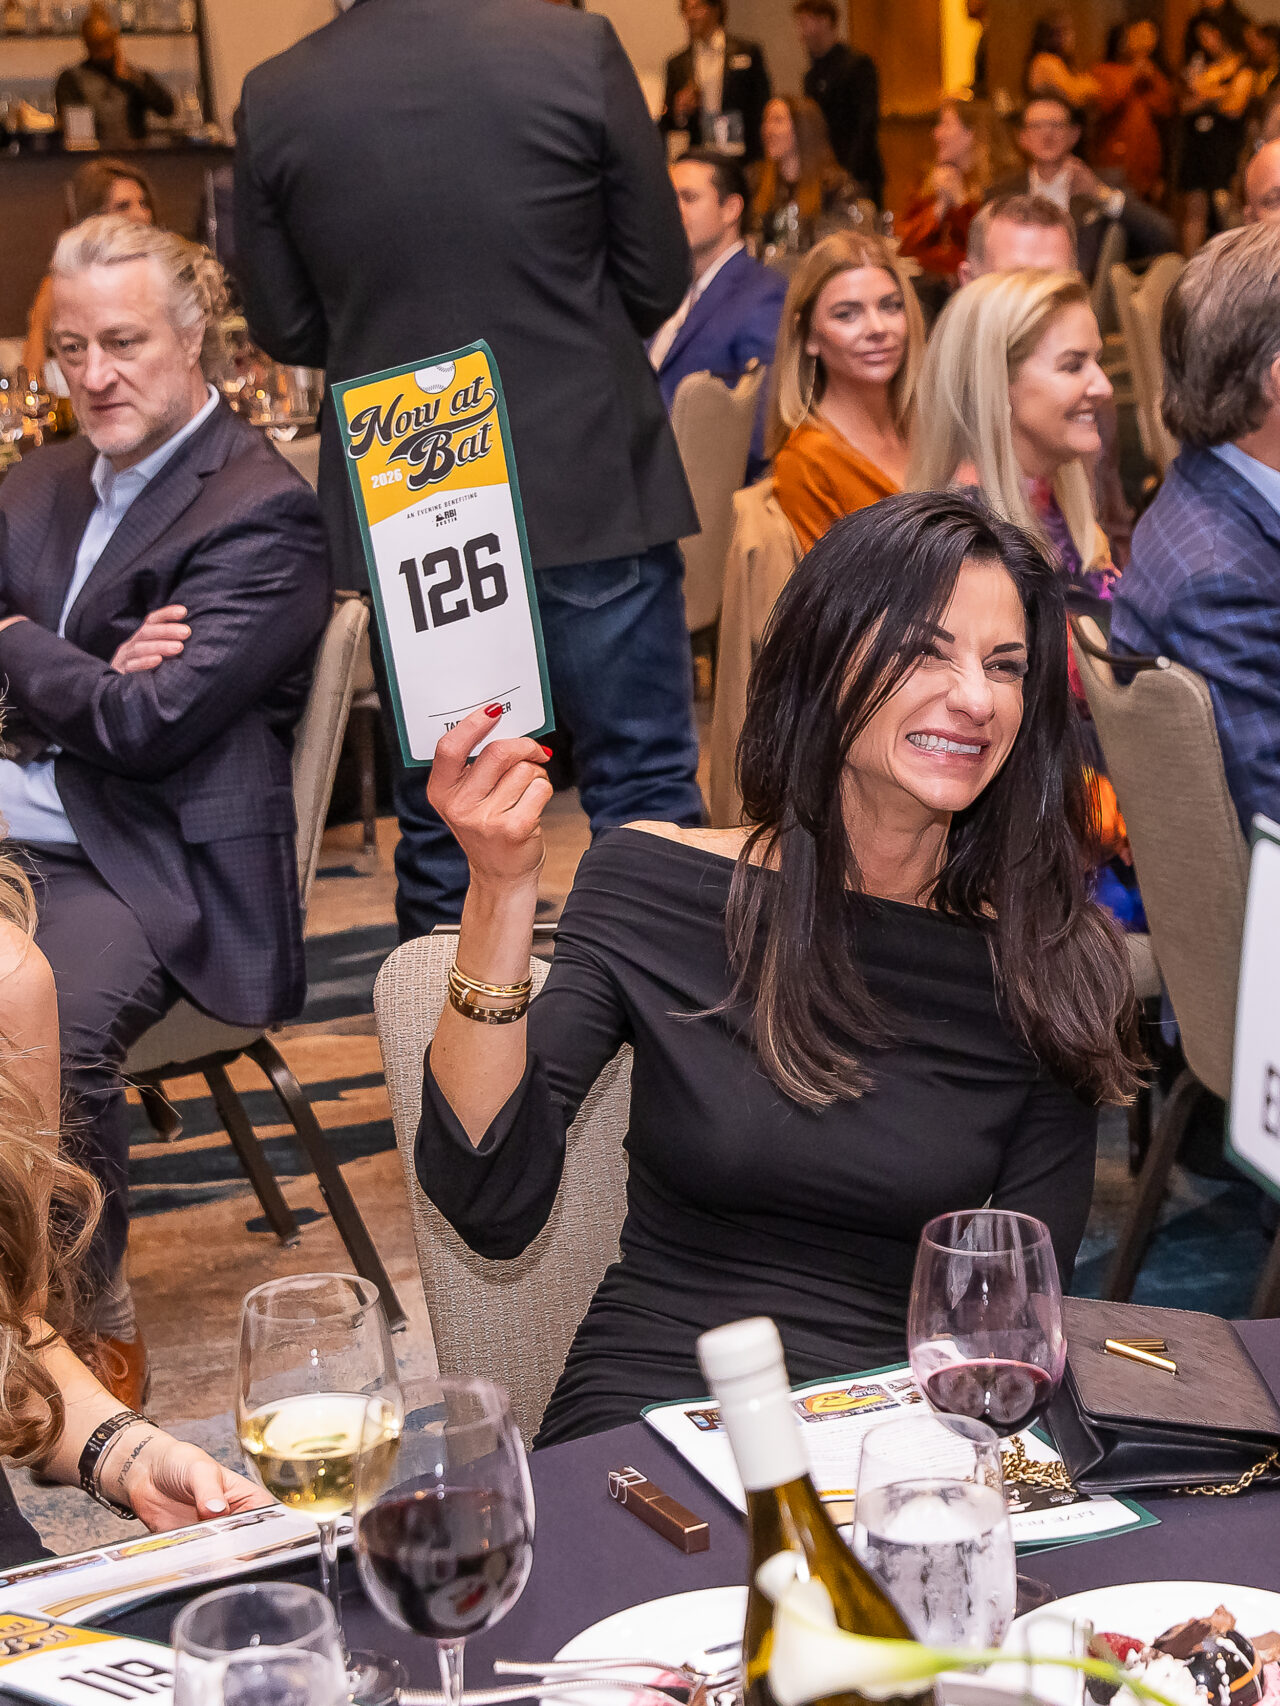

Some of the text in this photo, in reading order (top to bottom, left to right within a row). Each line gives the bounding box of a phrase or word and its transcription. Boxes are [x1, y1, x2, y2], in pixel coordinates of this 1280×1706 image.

[347, 376, 485, 460] Now at
[371, 468, 403, 489] 2026
[388, 420, 495, 491] Bat
[407, 492, 478, 519] AN EVENING BENEFITING
[444, 508, 457, 520] RBI
[399, 532, 509, 634] 126
